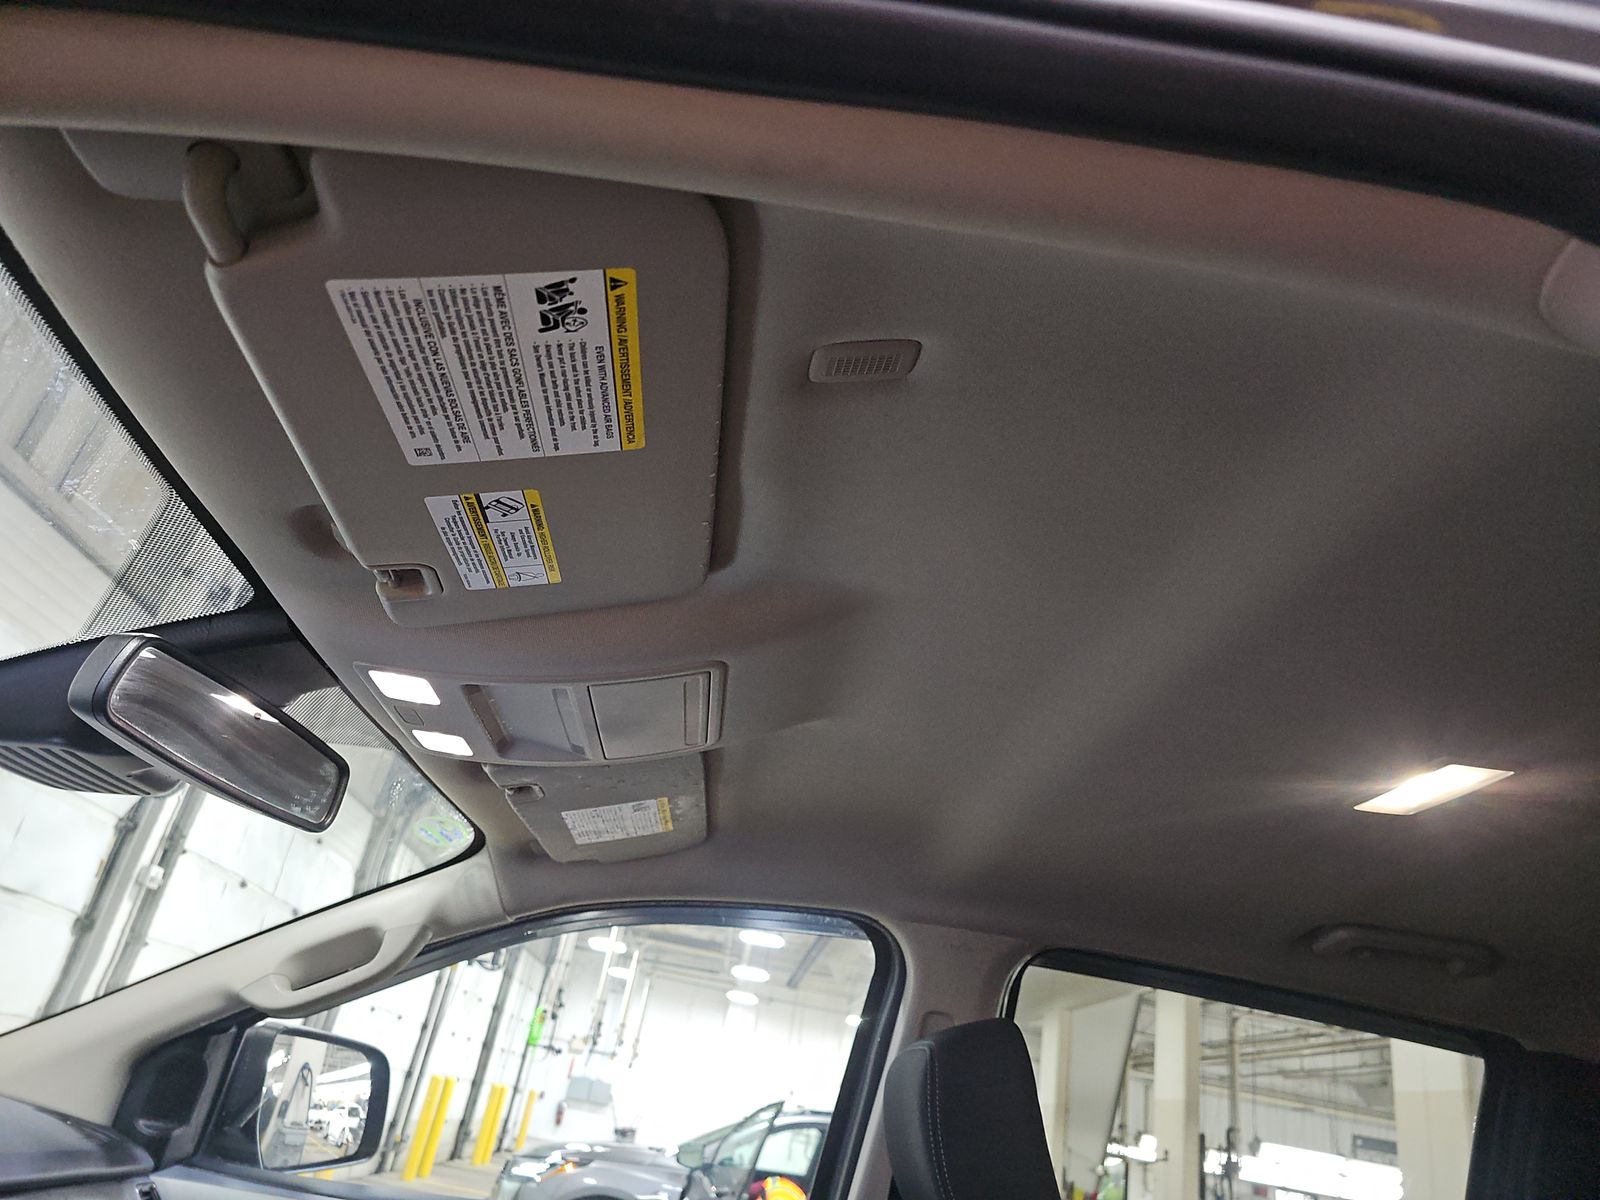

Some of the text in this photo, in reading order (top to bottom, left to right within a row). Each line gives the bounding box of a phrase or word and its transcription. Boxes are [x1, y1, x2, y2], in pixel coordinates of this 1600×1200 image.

[498, 310, 511, 330] AVEC
[614, 294, 627, 333] WARNING
[503, 332, 515, 346] DES
[507, 348, 520, 367] SACS
[413, 299, 471, 444] INCLUSIVE CON LAS NUEVAS BOLSAS DE AIRE
[512, 368, 529, 408] GONFLABLES
[595, 346, 614, 439] EVEN WITH ADVANCED AIR BAGS
[466, 502, 488, 539] AVERTISSEMENT
